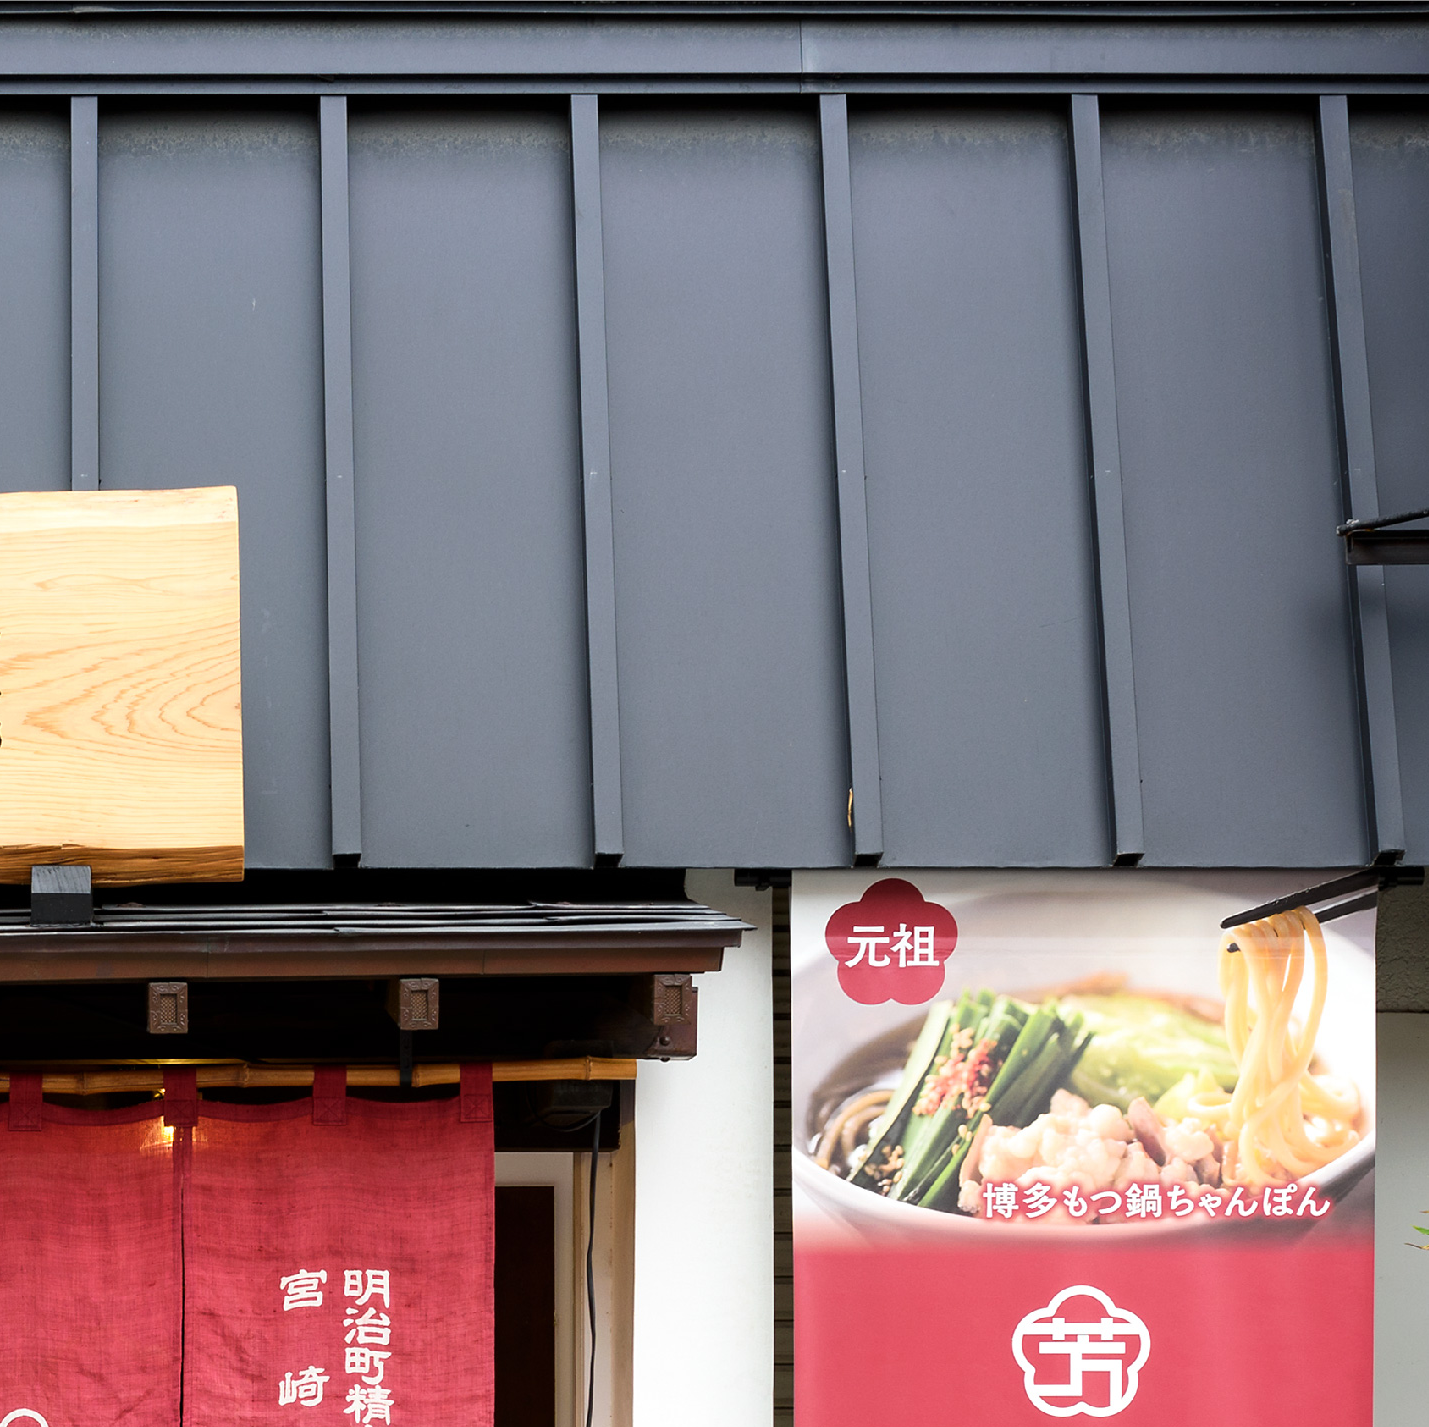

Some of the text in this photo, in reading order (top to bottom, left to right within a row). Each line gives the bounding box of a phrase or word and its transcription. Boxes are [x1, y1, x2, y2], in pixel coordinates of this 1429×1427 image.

[845, 922, 940, 969] 元祖
[983, 1181, 1331, 1219] 博多もつ鍋ちゃんぽん
